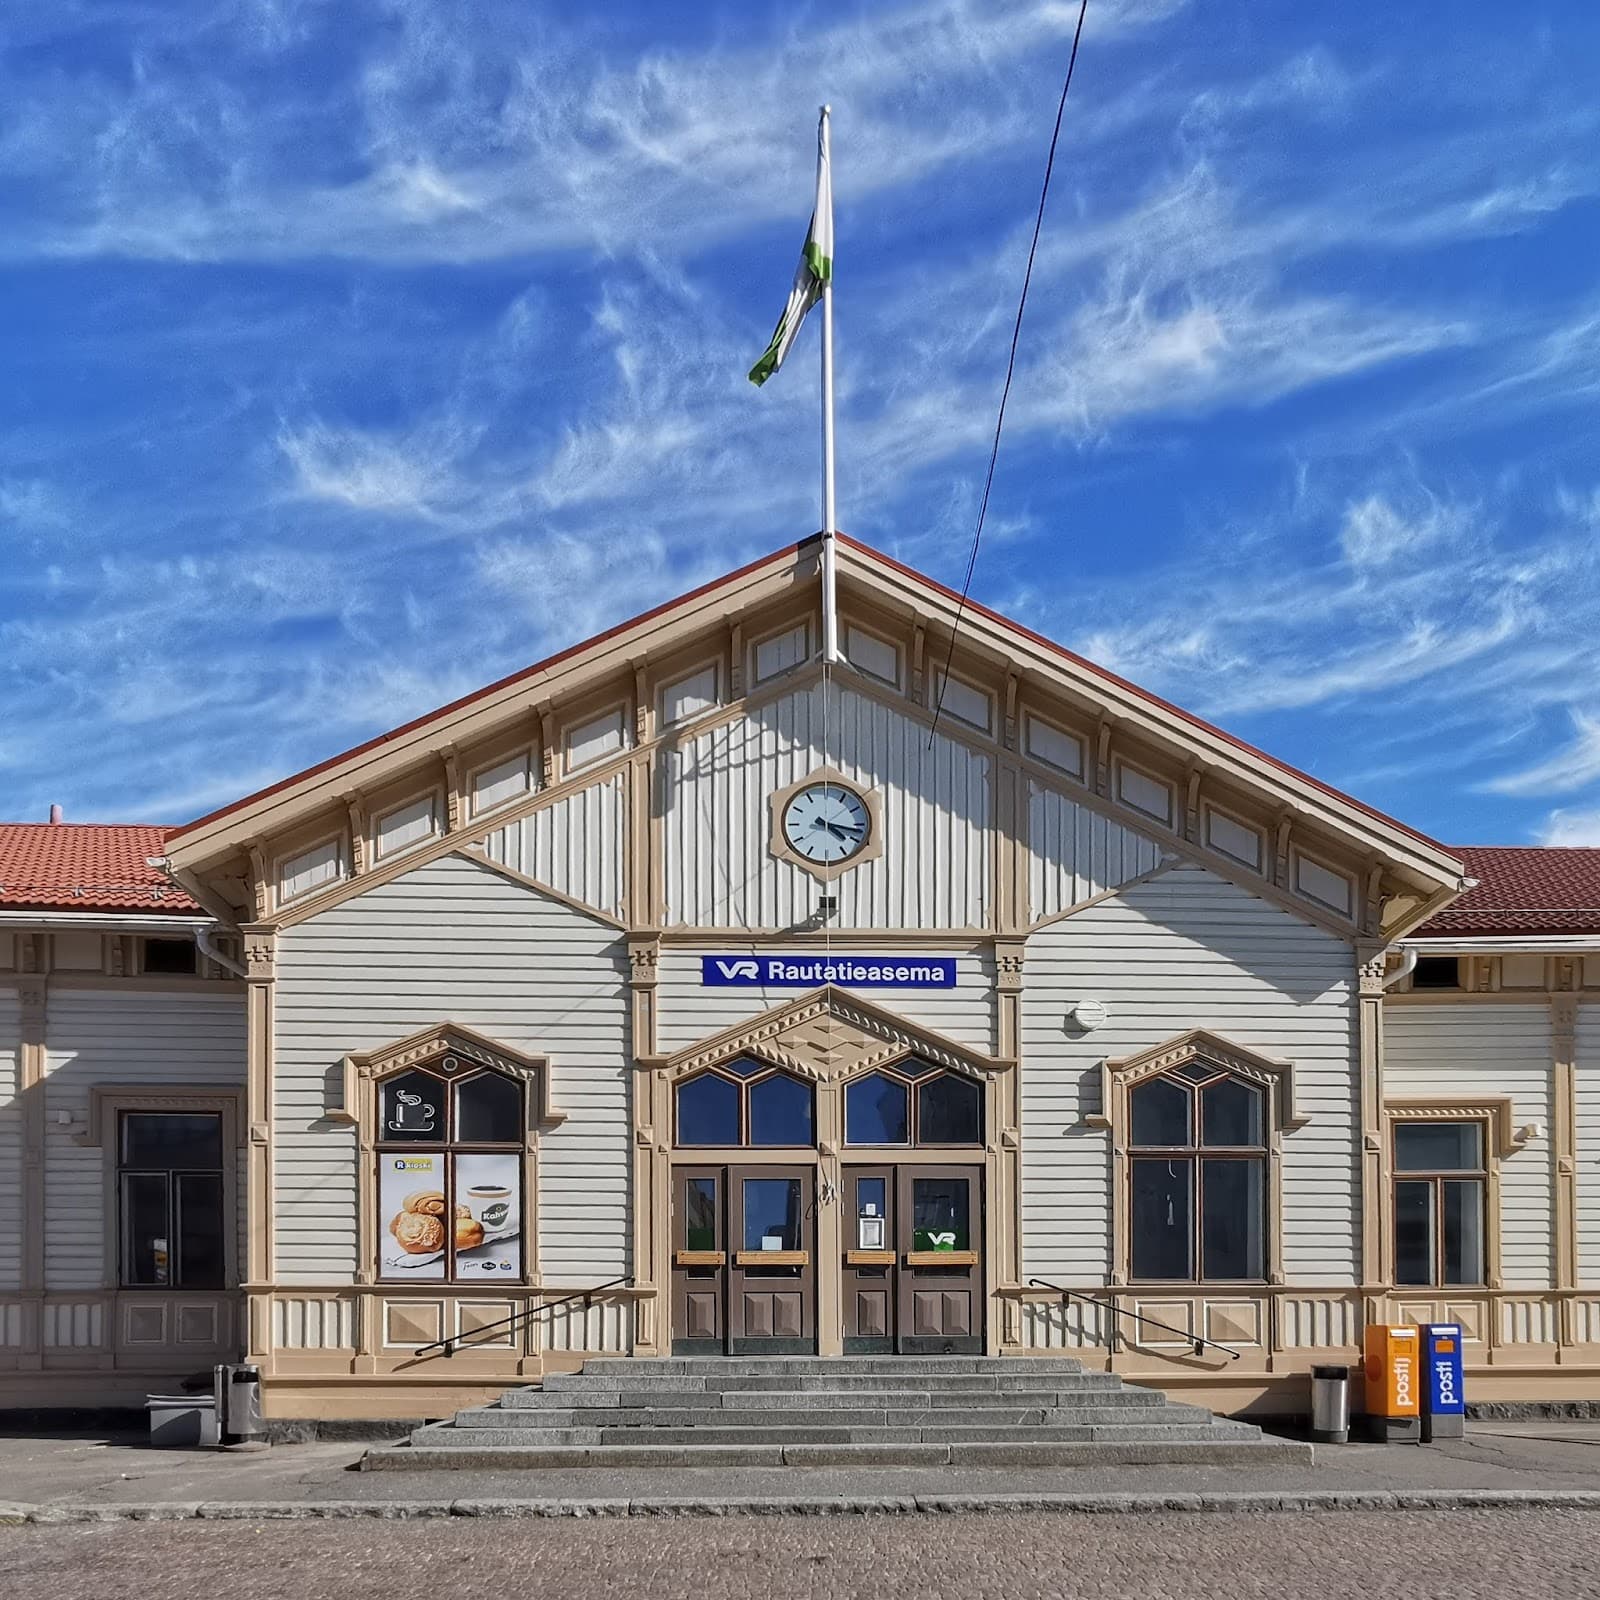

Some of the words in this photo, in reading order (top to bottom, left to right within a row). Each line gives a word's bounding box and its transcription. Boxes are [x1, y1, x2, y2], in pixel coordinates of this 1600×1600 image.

[715, 960, 760, 980] VR
[768, 961, 945, 982] Rautatieasema
[927, 1232, 956, 1245] VR
[1435, 1361, 1459, 1405] posti
